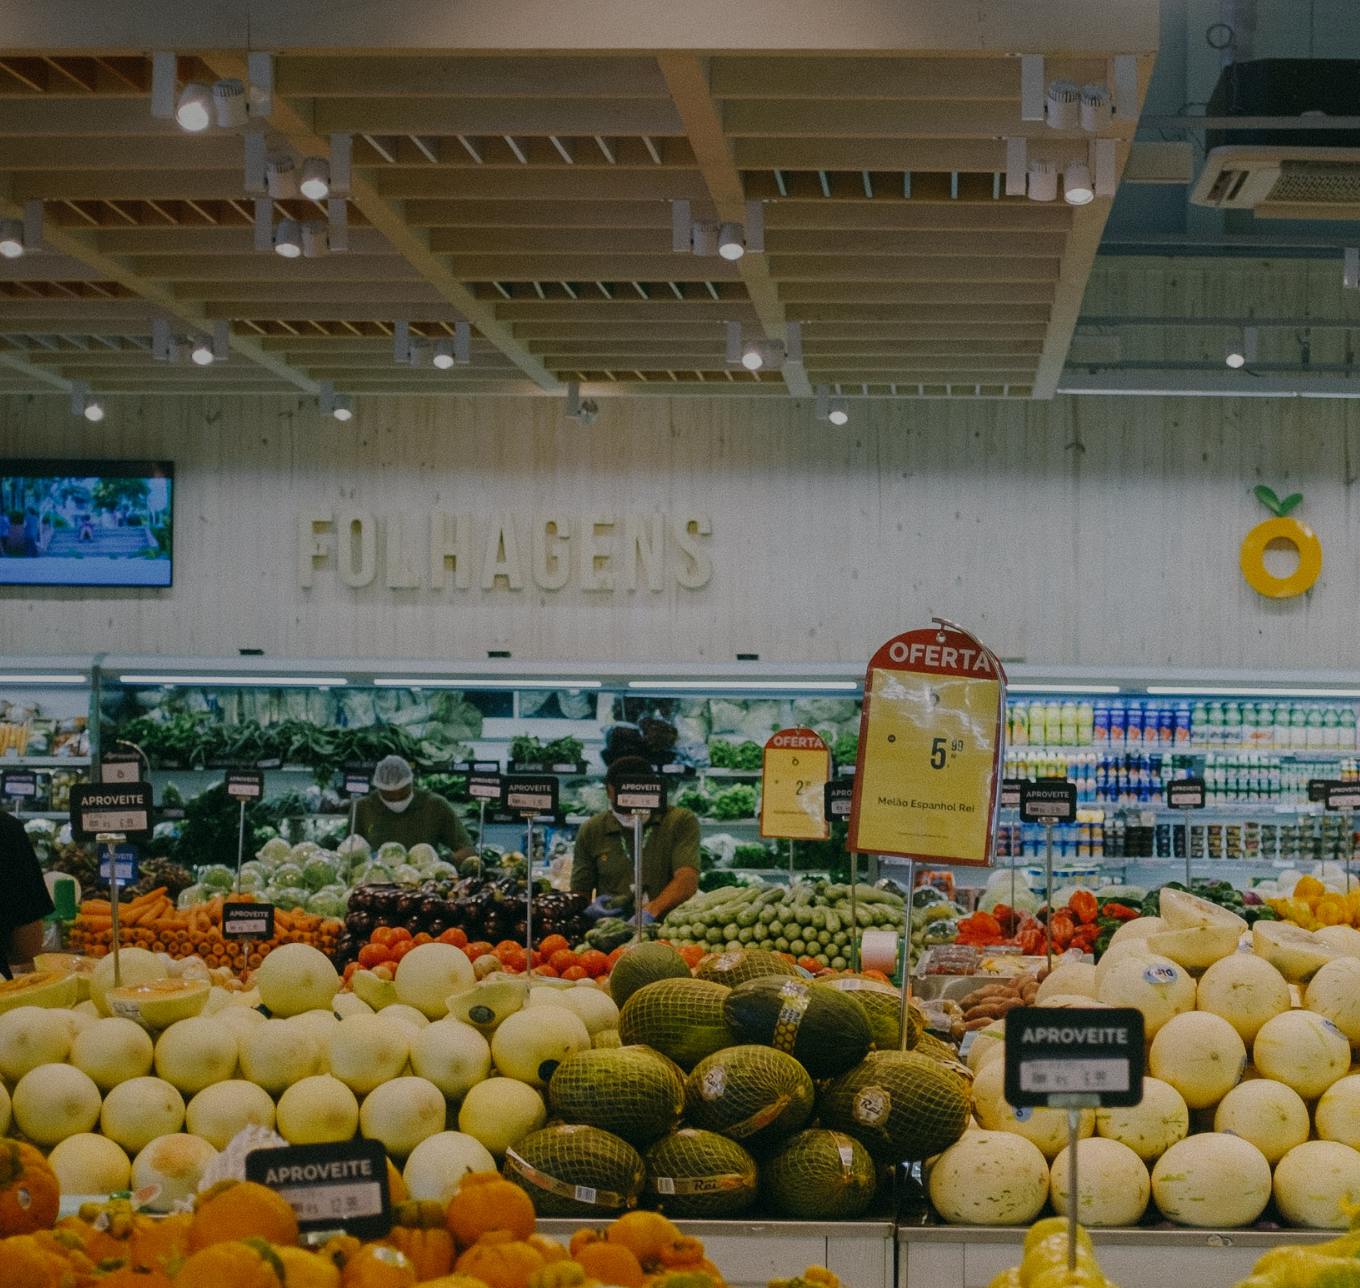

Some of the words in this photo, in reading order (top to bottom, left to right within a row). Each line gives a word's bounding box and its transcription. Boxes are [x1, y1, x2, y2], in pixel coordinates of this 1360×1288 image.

[300, 510, 714, 592] FOLHAGENS
[888, 641, 992, 673] OFERTA
[773, 735, 824, 749] OFERTA
[508, 784, 552, 792] APROVEITE
[621, 783, 662, 792] APROVEITE
[81, 794, 144, 806] APROVEITE
[1026, 791, 1070, 799] APROVEITE
[910, 799, 957, 813] Espanhol
[959, 803, 975, 813] Rei
[1021, 1027, 1128, 1044] APROVEITE
[861, 1098, 883, 1115] Rei
[265, 1159, 372, 1185] APROVEITE
[694, 1179, 716, 1191] Rei
